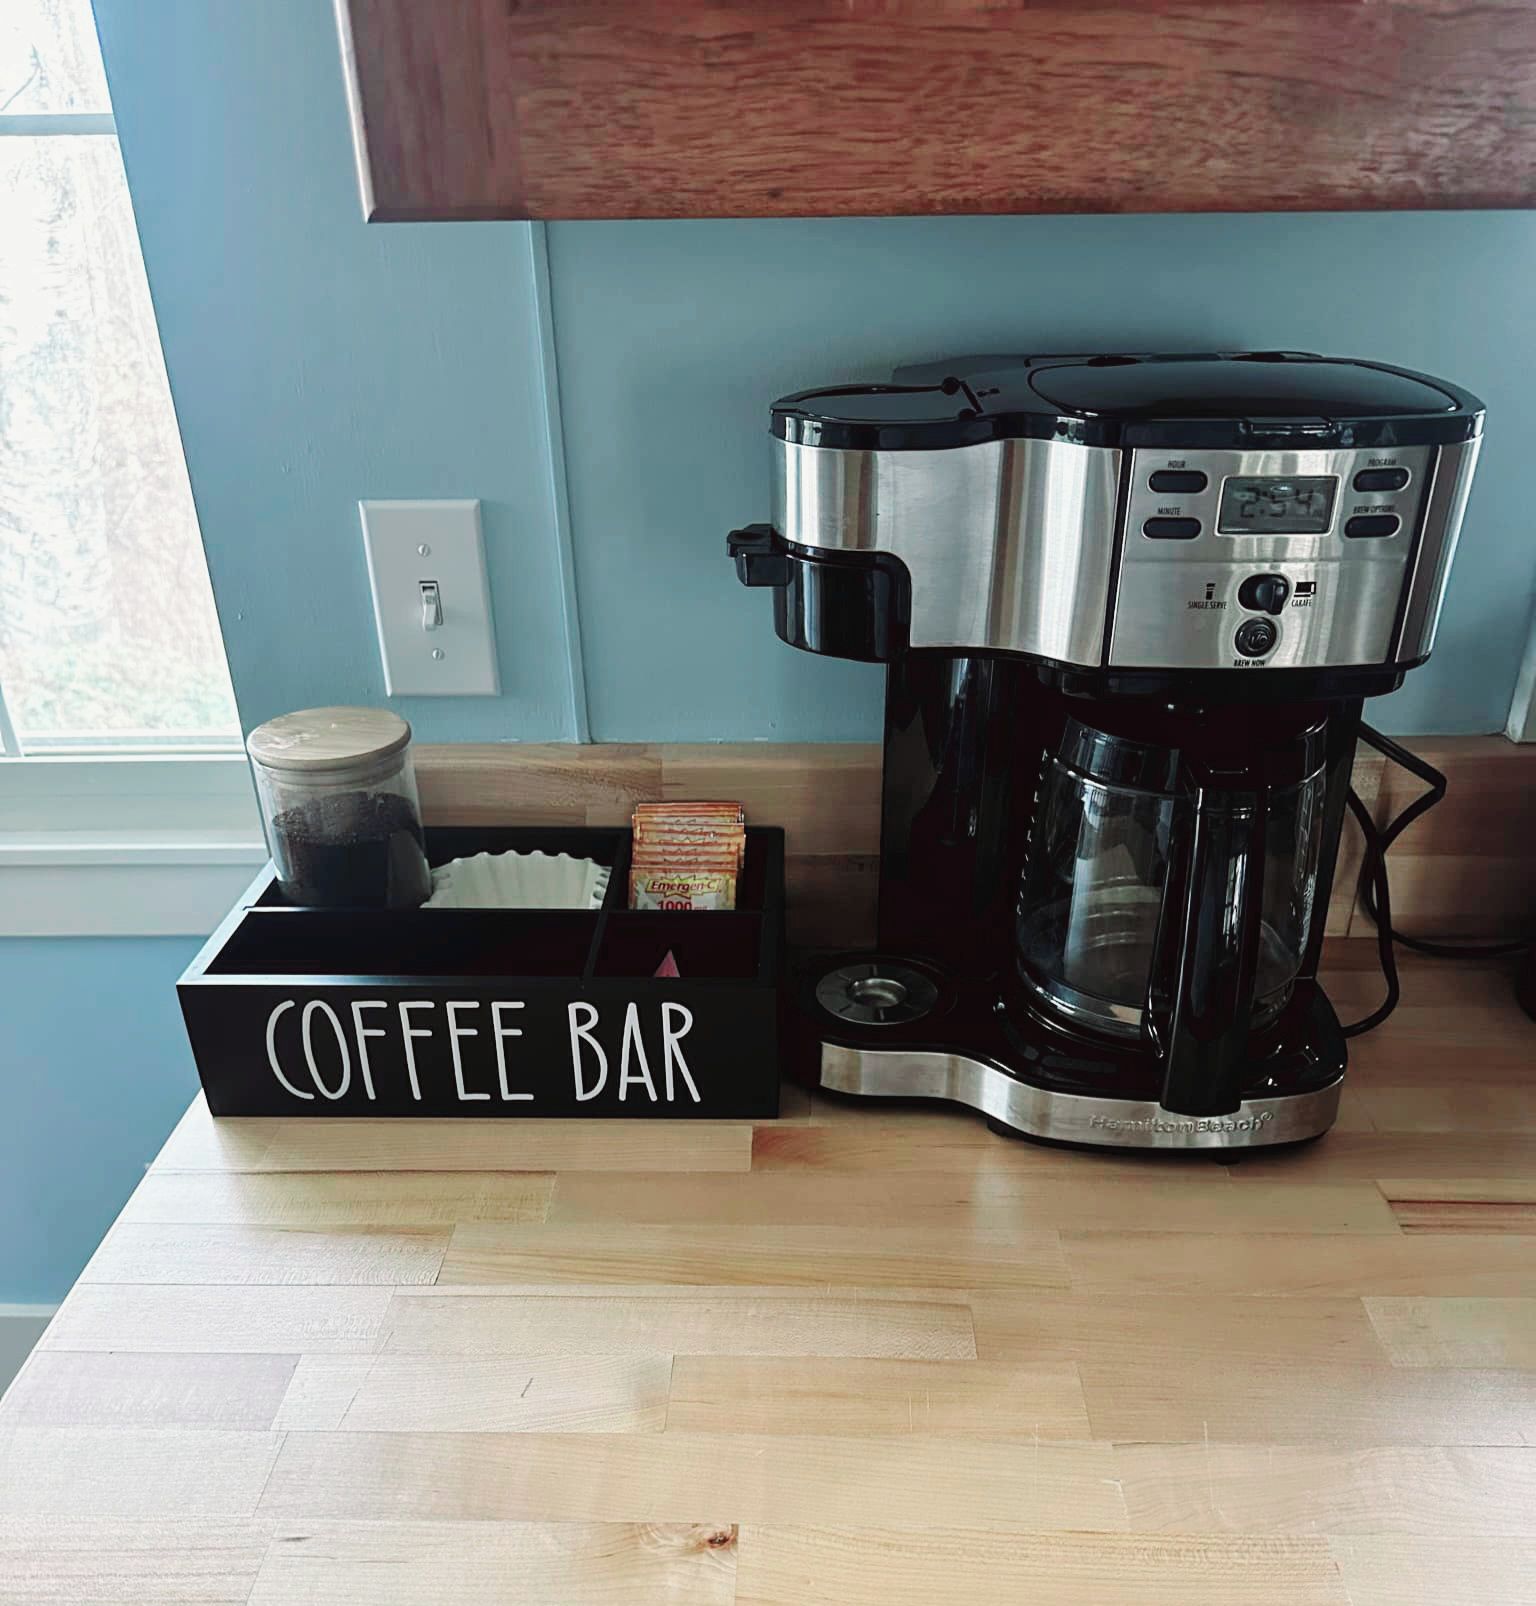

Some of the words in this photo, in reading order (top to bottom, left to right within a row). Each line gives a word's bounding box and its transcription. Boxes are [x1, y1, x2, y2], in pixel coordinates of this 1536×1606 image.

[1157, 507, 1182, 516] MINUTE
[1187, 601, 1208, 610] SINGLE
[1208, 600, 1227, 610] SERVE
[1291, 599, 1313, 608] CARAFE
[1233, 659, 1251, 667] BREW
[1251, 659, 1265, 667] NOW
[266, 1000, 535, 1101] COFFEE
[568, 1001, 702, 1103] BAR
